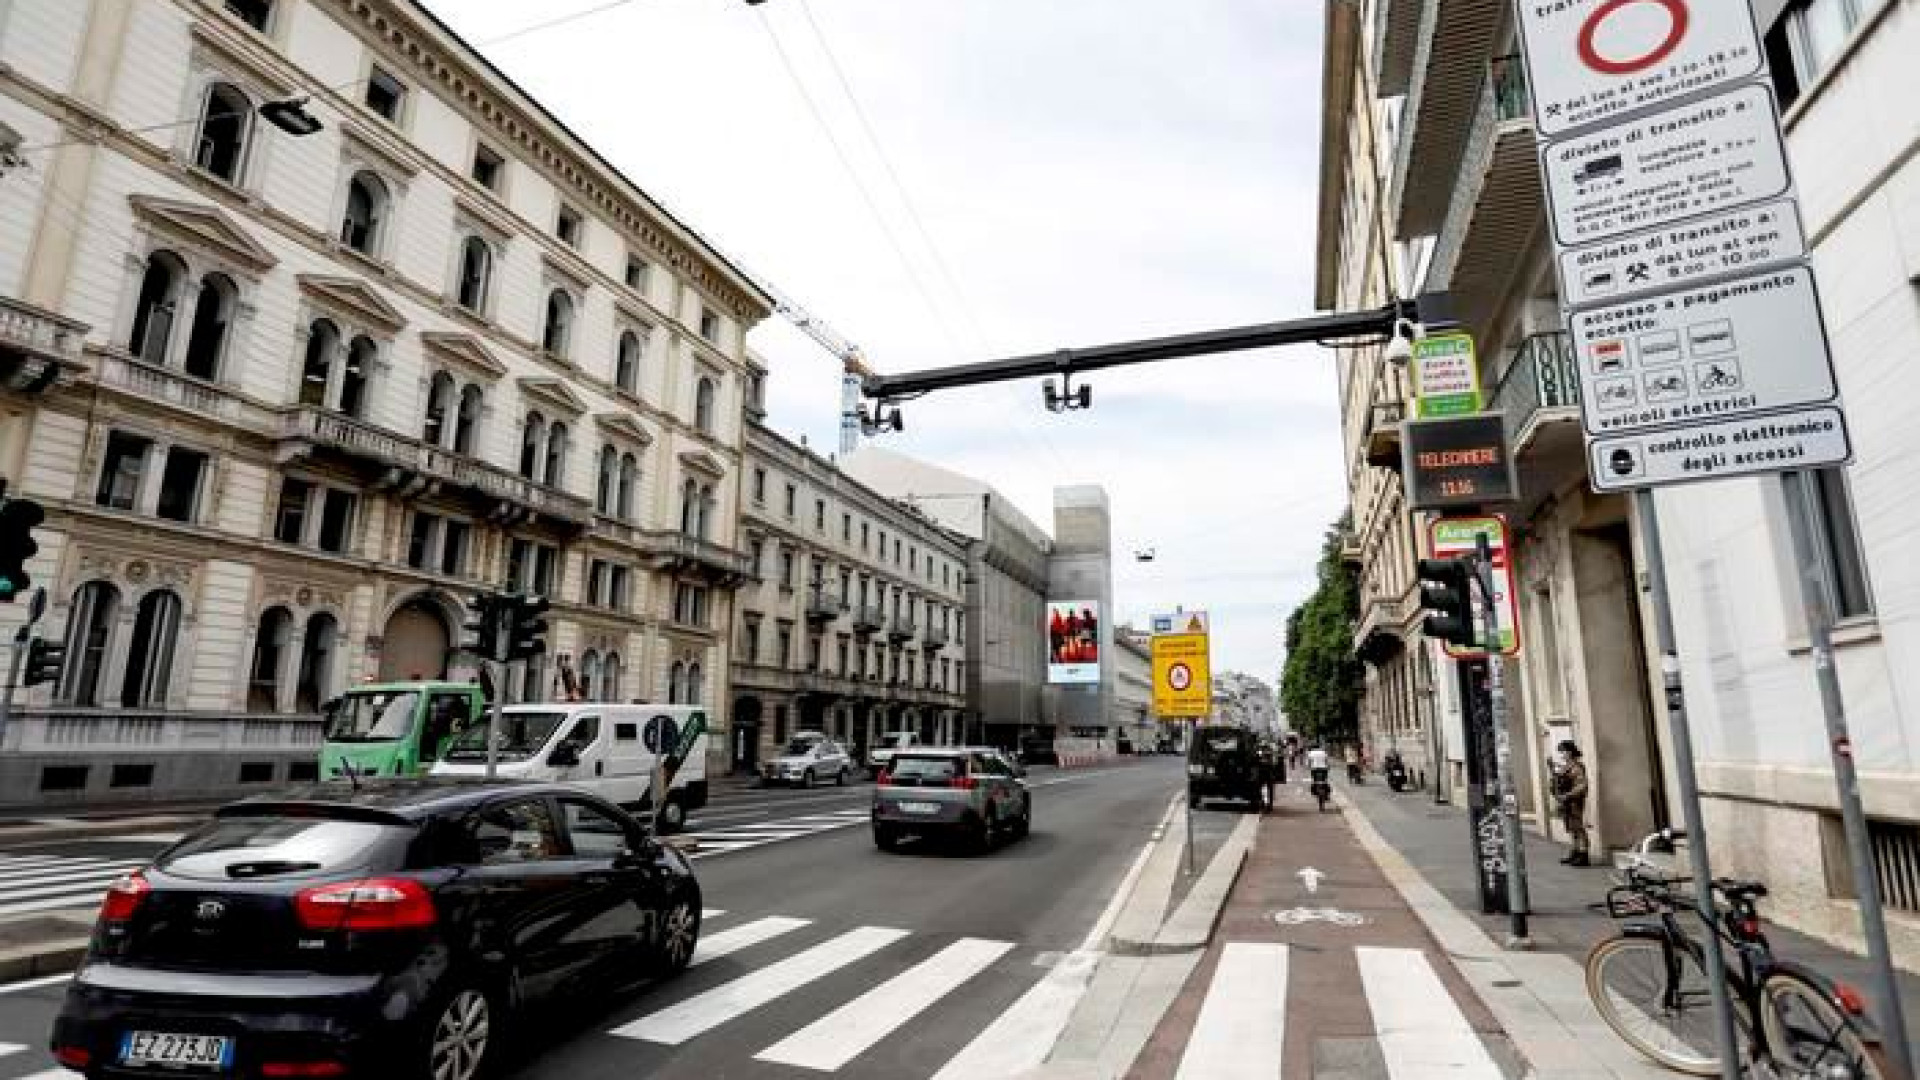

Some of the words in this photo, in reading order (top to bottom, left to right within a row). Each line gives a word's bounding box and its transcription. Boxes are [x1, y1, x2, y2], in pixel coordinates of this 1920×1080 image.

[1569, 100, 1628, 122] eccetto
[1636, 67, 1727, 101] autorizzati
[1560, 139, 1622, 162] divieto
[1626, 129, 1643, 143] di
[1650, 108, 1726, 136] transito
[1577, 244, 1639, 265] divieto
[1646, 235, 1663, 250] di
[1669, 218, 1750, 244] transito
[1758, 210, 1777, 223] a:
[1654, 251, 1682, 266] dal
[1687, 244, 1718, 258] lun
[1722, 237, 1740, 251] al
[1747, 230, 1779, 245] ven
[1584, 303, 1658, 326] accesso
[1665, 299, 1674, 309] a
[1683, 275, 1795, 308] pagamento
[1585, 319, 1655, 340] eccetto
[1601, 407, 1666, 429] veicoli
[1671, 394, 1757, 417] elettrici
[1648, 432, 1727, 454] controllo
[1732, 418, 1834, 445] elettronico
[1418, 447, 1498, 467] TELECAMERE
[1682, 452, 1727, 472] degli
[1733, 443, 1804, 465] accessi
[132, 1032, 160, 1059] EZ
